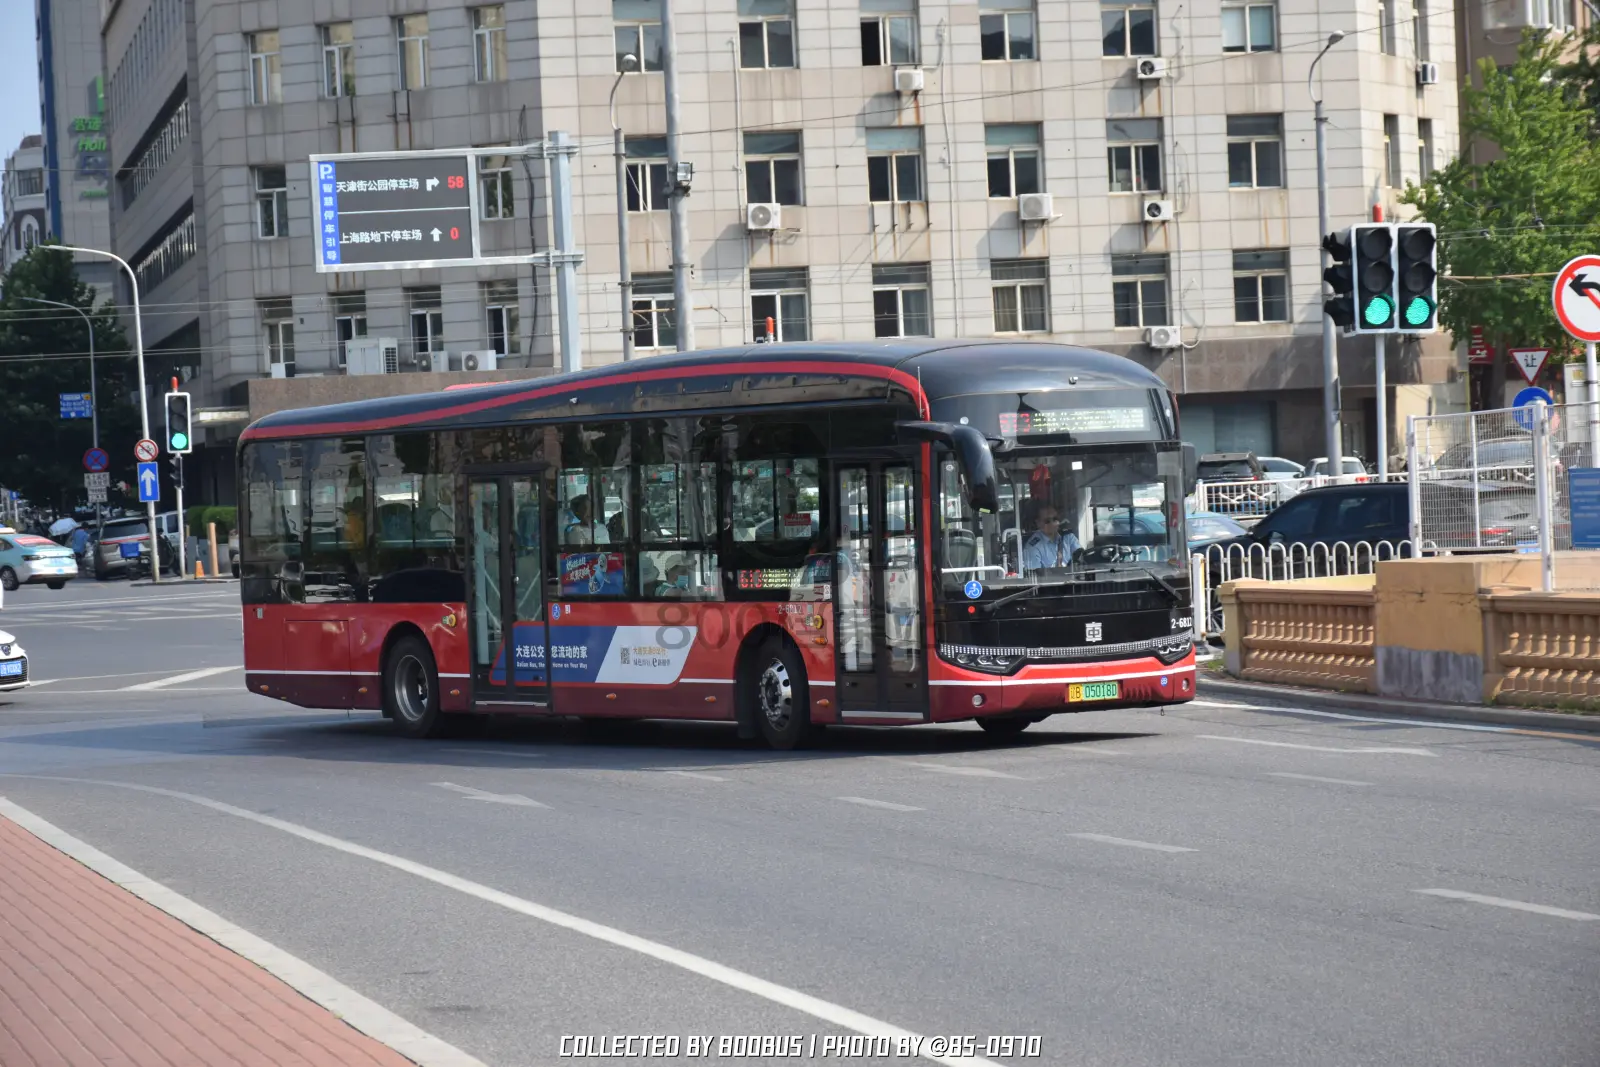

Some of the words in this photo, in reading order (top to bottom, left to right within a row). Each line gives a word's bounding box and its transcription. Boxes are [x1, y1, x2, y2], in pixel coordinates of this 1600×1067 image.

[336, 178, 420, 193] 天津街公园停车场
[447, 176, 464, 188] 58
[322, 183, 337, 261] 智慧停车引导
[339, 229, 422, 245] 上海路地下停车场
[450, 227, 459, 240] 0
[1524, 354, 1537, 368] 让
[1171, 617, 1192, 629] 2-6812
[515, 644, 545, 658] 大连公交
[551, 645, 588, 659] 您流动的家
